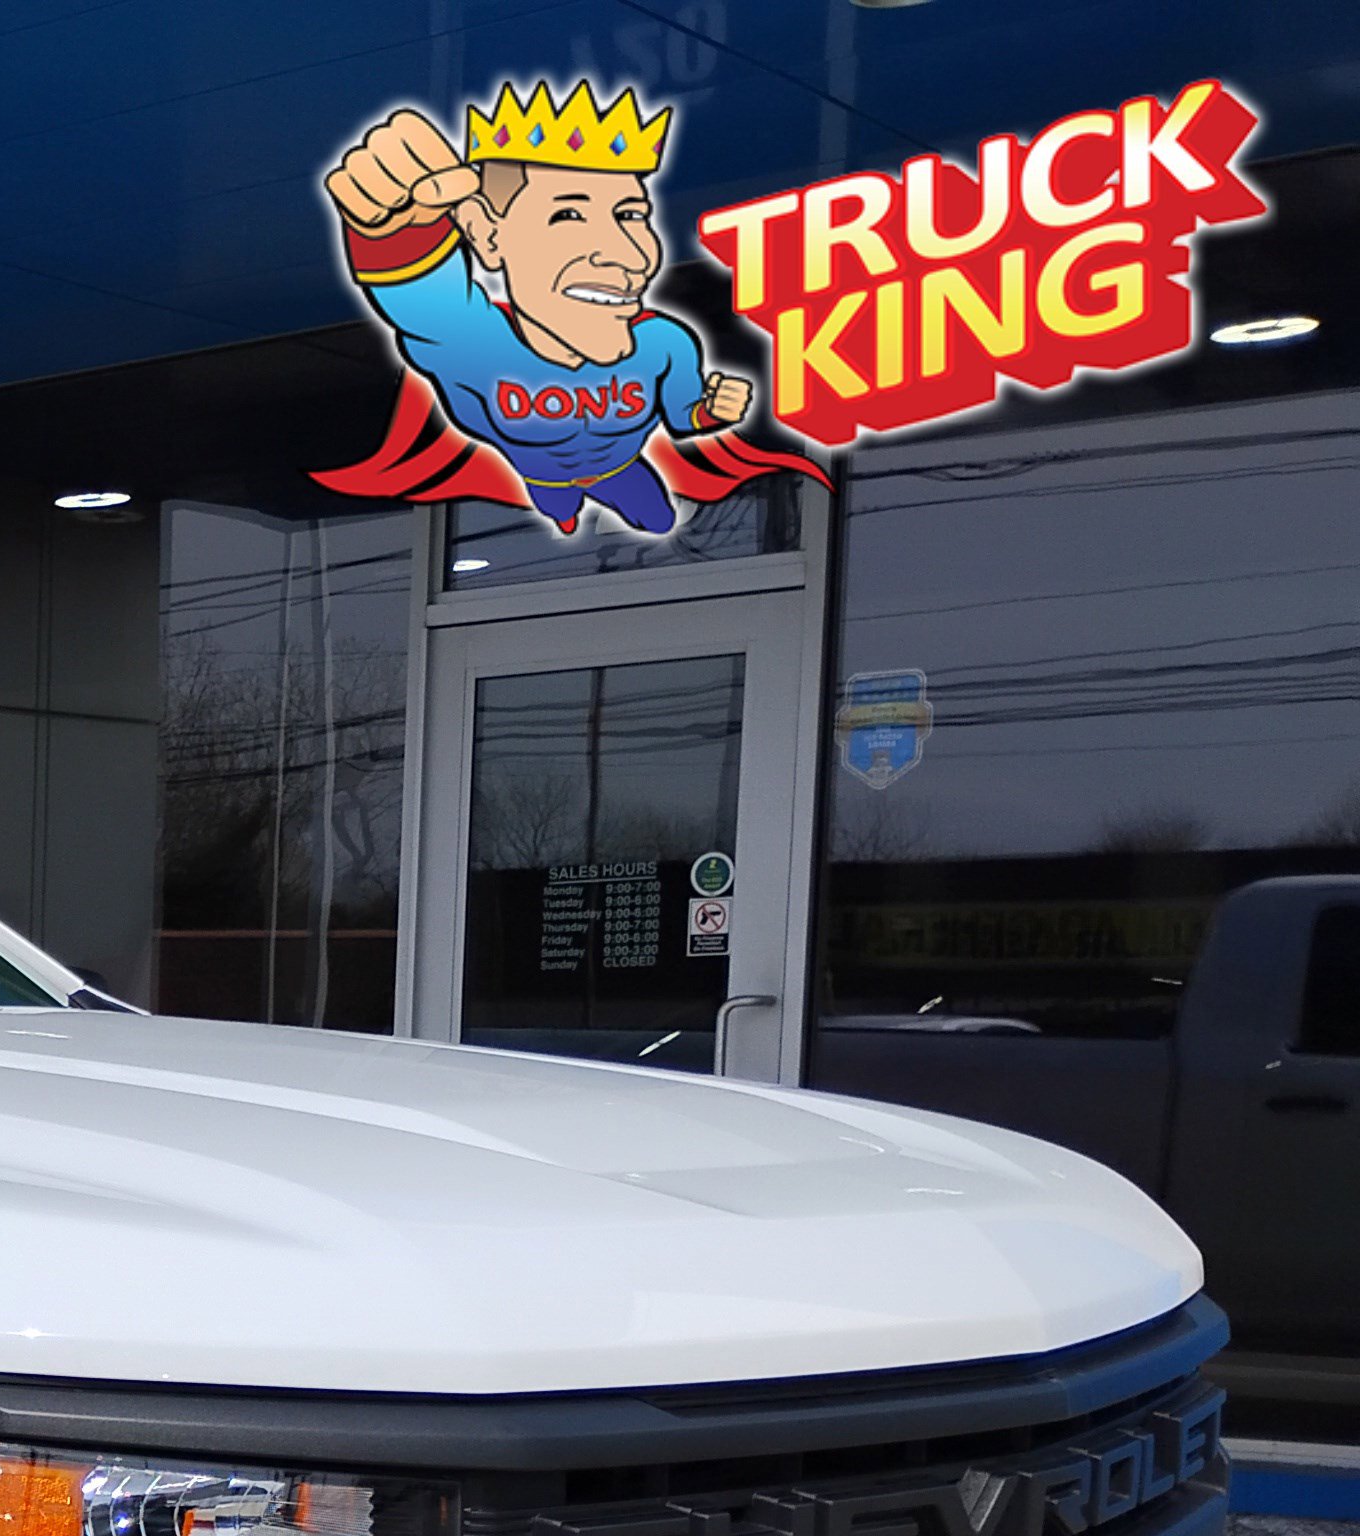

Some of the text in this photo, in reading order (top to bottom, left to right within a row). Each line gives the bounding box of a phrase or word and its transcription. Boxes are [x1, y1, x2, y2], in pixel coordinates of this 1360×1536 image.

[549, 862, 657, 879] SALES HOURS
[543, 887, 583, 897] Monday
[543, 899, 583, 909] Tuesday
[542, 910, 601, 921] Wednesday
[542, 923, 588, 933] Thursday
[541, 936, 572, 946] Friday
[541, 949, 585, 959] Saturday
[540, 957, 656, 971] Sunday CLOSED
